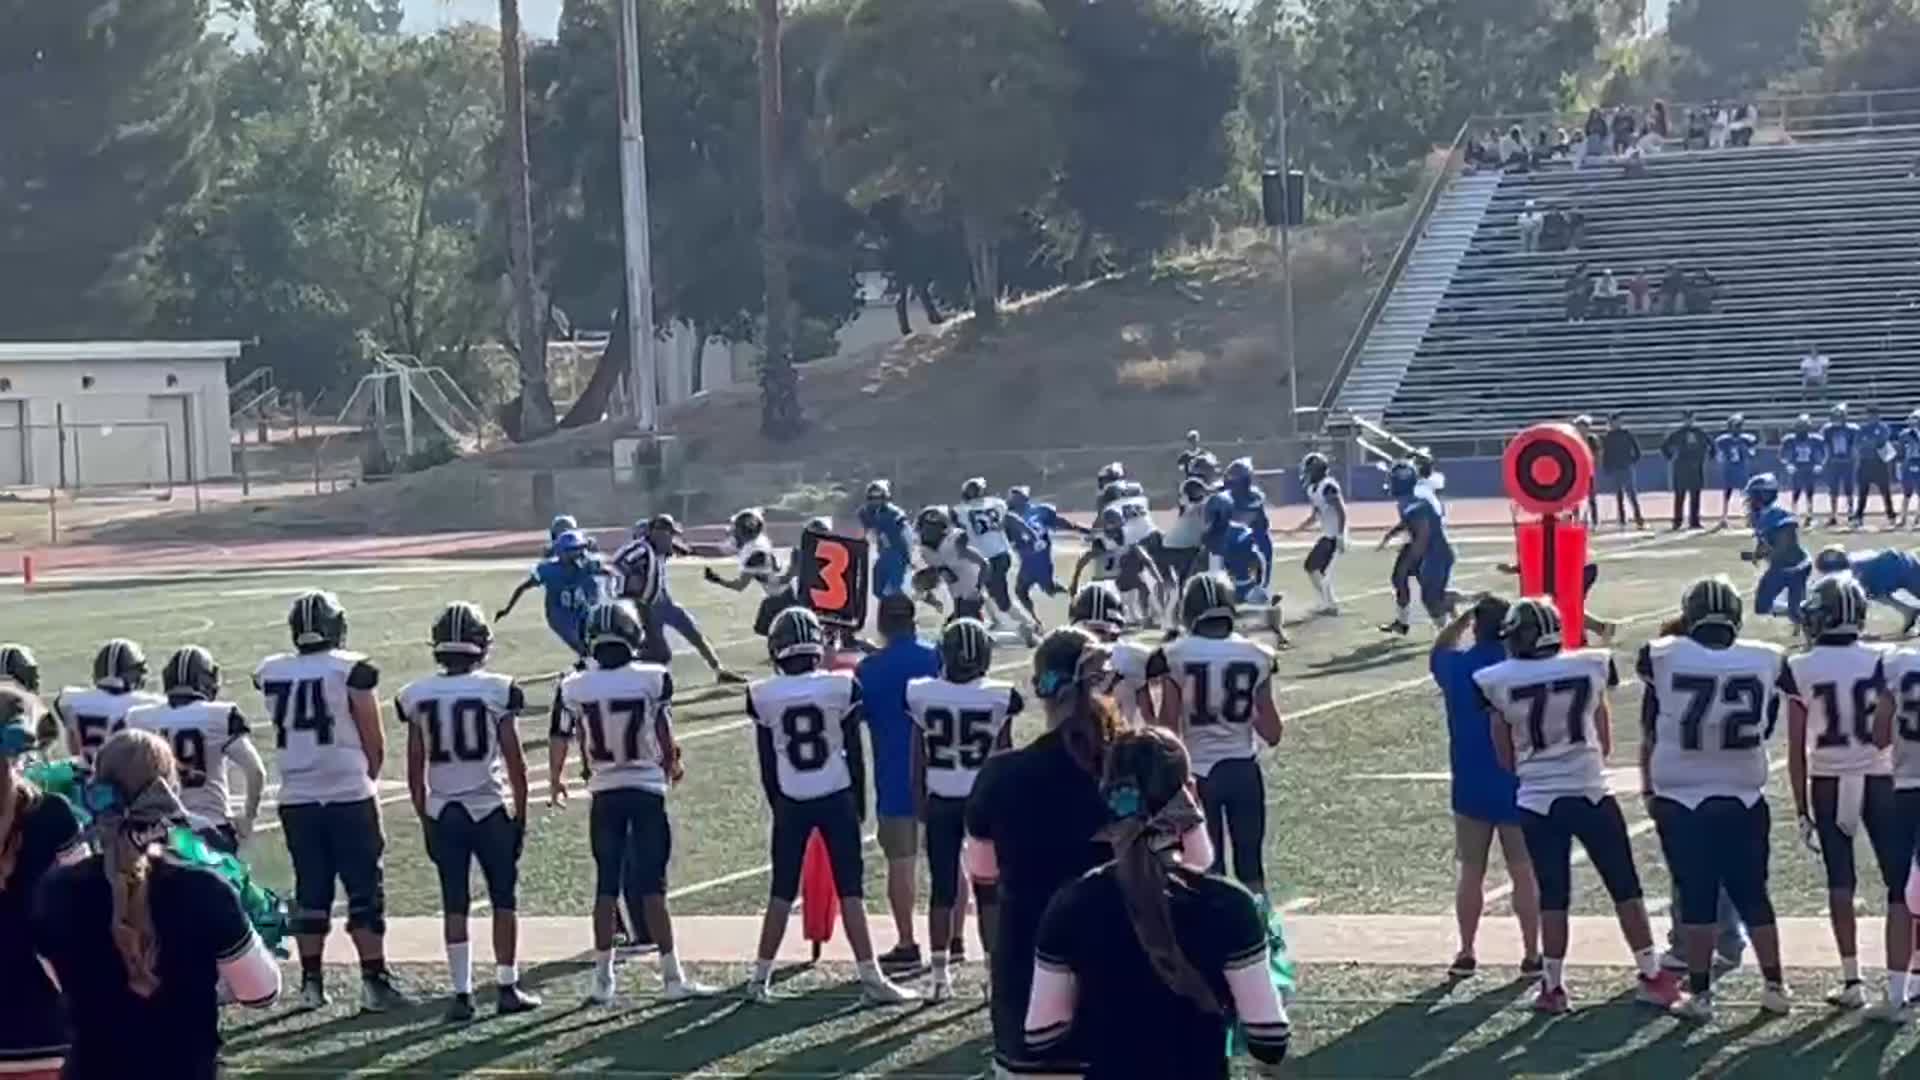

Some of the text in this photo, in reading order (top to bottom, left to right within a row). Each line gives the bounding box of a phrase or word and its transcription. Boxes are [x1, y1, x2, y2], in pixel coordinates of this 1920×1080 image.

[809, 538, 850, 611] 3
[264, 677, 335, 749] 74
[1184, 661, 1260, 727] 18
[1509, 674, 1592, 752] 77
[1671, 672, 1764, 750] 72
[1811, 677, 1883, 748] 16
[415, 698, 489, 762] 10
[582, 698, 646, 762] 17
[780, 703, 829, 771] 8
[923, 705, 993, 770] 25
